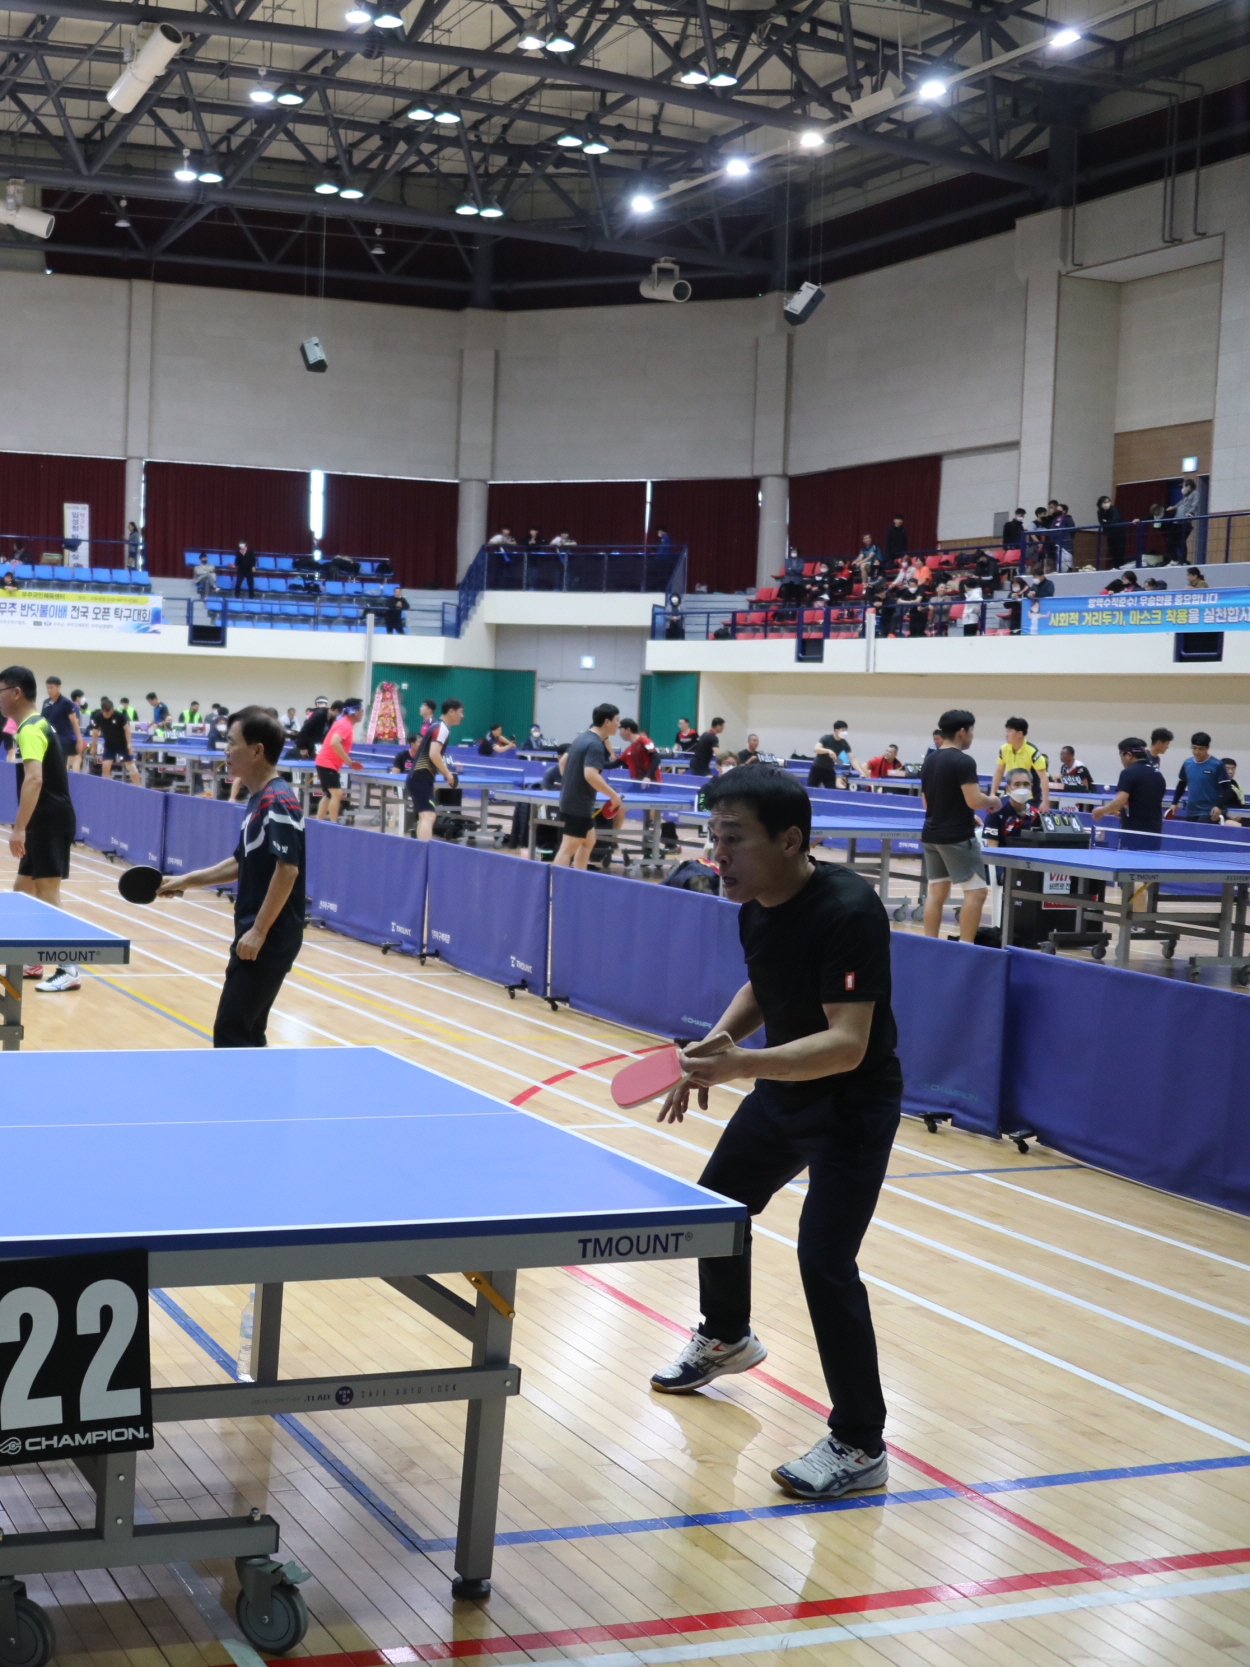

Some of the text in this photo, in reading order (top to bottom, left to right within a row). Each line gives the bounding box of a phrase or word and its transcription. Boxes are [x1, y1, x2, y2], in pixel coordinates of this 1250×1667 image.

[1088, 592, 1219, 608] 방역수칙준수! 우승만큼 중요합니다
[20, 603, 68, 619] 반딧불이배
[70, 605, 90, 620] 전국
[92, 607, 111, 621] 오픈
[113, 608, 151, 623] 탁구대회
[1048, 611, 1080, 627] 사회적
[1081, 610, 1127, 627] 거리두기,
[1129, 609, 1162, 626] 마스크
[1165, 608, 1200, 625] 착용을
[1044, 816, 1055, 831] 3
[1071, 817, 1081, 832] 4
[37, 950, 96, 962] TMOUNT
[577, 1232, 685, 1259] TMOUNT
